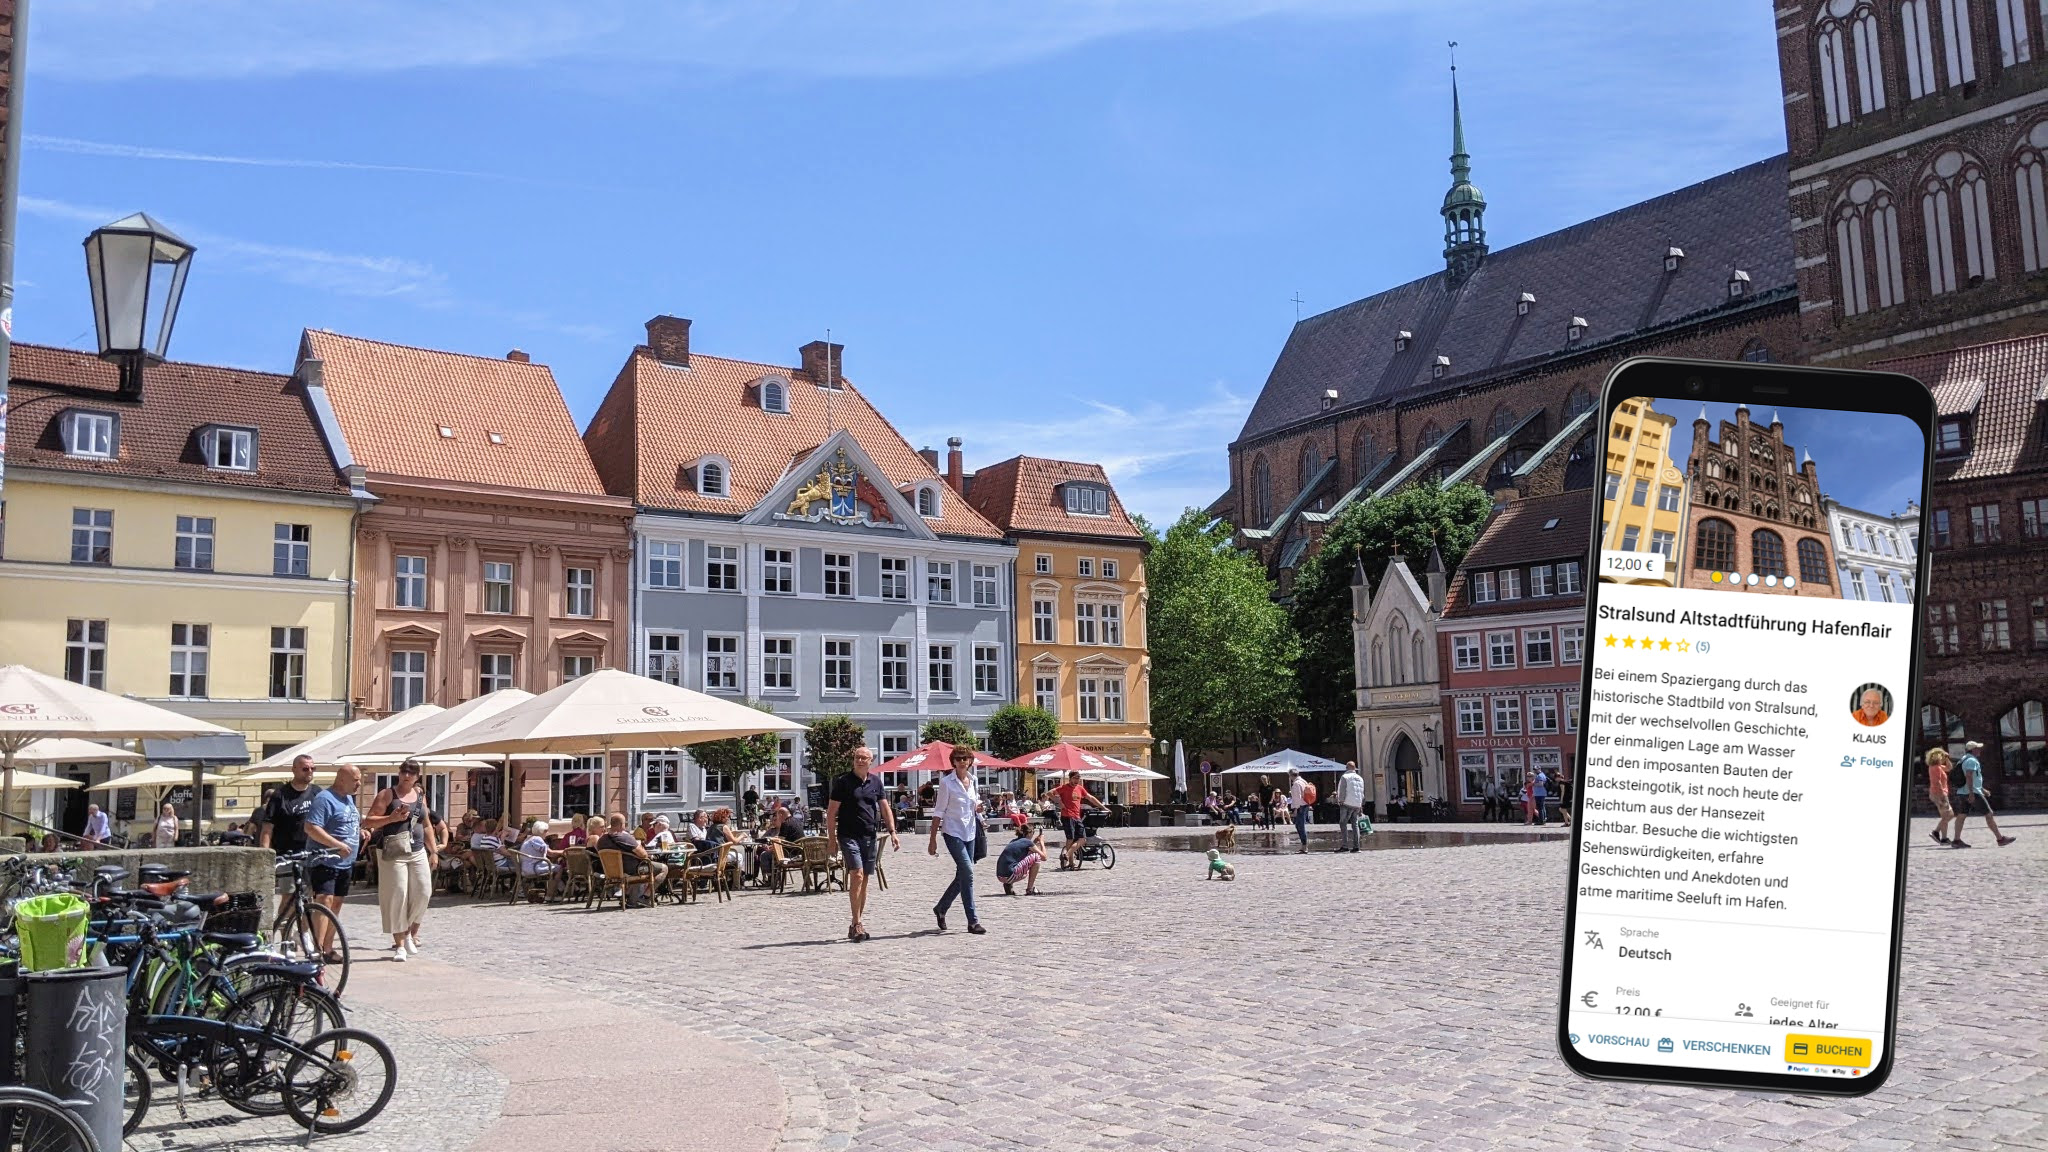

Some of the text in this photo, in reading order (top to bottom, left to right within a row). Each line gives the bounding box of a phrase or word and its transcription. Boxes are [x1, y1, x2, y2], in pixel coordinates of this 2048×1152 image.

[1607, 558, 1654, 572] 12,00 €
[1598, 605, 1893, 639] Stralsund Altstadtführung Hafenflair
[1695, 641, 1711, 655] (5)
[1594, 668, 1808, 694] Bei einem Spaziergang durch das
[1592, 689, 1819, 719] historische Stadtbild von Stralsund,
[1591, 712, 1809, 739] mit der wechselvollen Geschichte,
[1471, 738, 1514, 748] NICOLAI
[1589, 733, 1796, 759] der einmaligen Lage am Wasser
[1852, 734, 1887, 745] KLAUS
[1587, 756, 1794, 780] und den imposanten Bauten der
[1859, 756, 1894, 769] Folgen
[1586, 776, 1804, 803] Backsteingotik, ist noch heute der
[169, 796, 186, 804] bar
[1585, 798, 1765, 822] Reichtum aus der Hansezeit
[1584, 820, 1799, 847] sichtbar. Besuche die wichtigsten
[1582, 841, 1765, 865] Sehenswürdigkeiten, erfahre
[1581, 863, 1789, 889] Geschichten und Anekdoten und
[1579, 886, 1787, 911] atme maritime Seeluft im Hafen.
[1619, 927, 1660, 939] Sprache
[1618, 946, 1672, 961] Deutsch
[1615, 986, 1641, 997] Preis
[1769, 997, 1830, 1010] Geeignet für
[1587, 1034, 1651, 1048] VORSCHAU
[1682, 1040, 1771, 1056] VERSCHENKEN
[1816, 1044, 1863, 1057] BUCHEN
